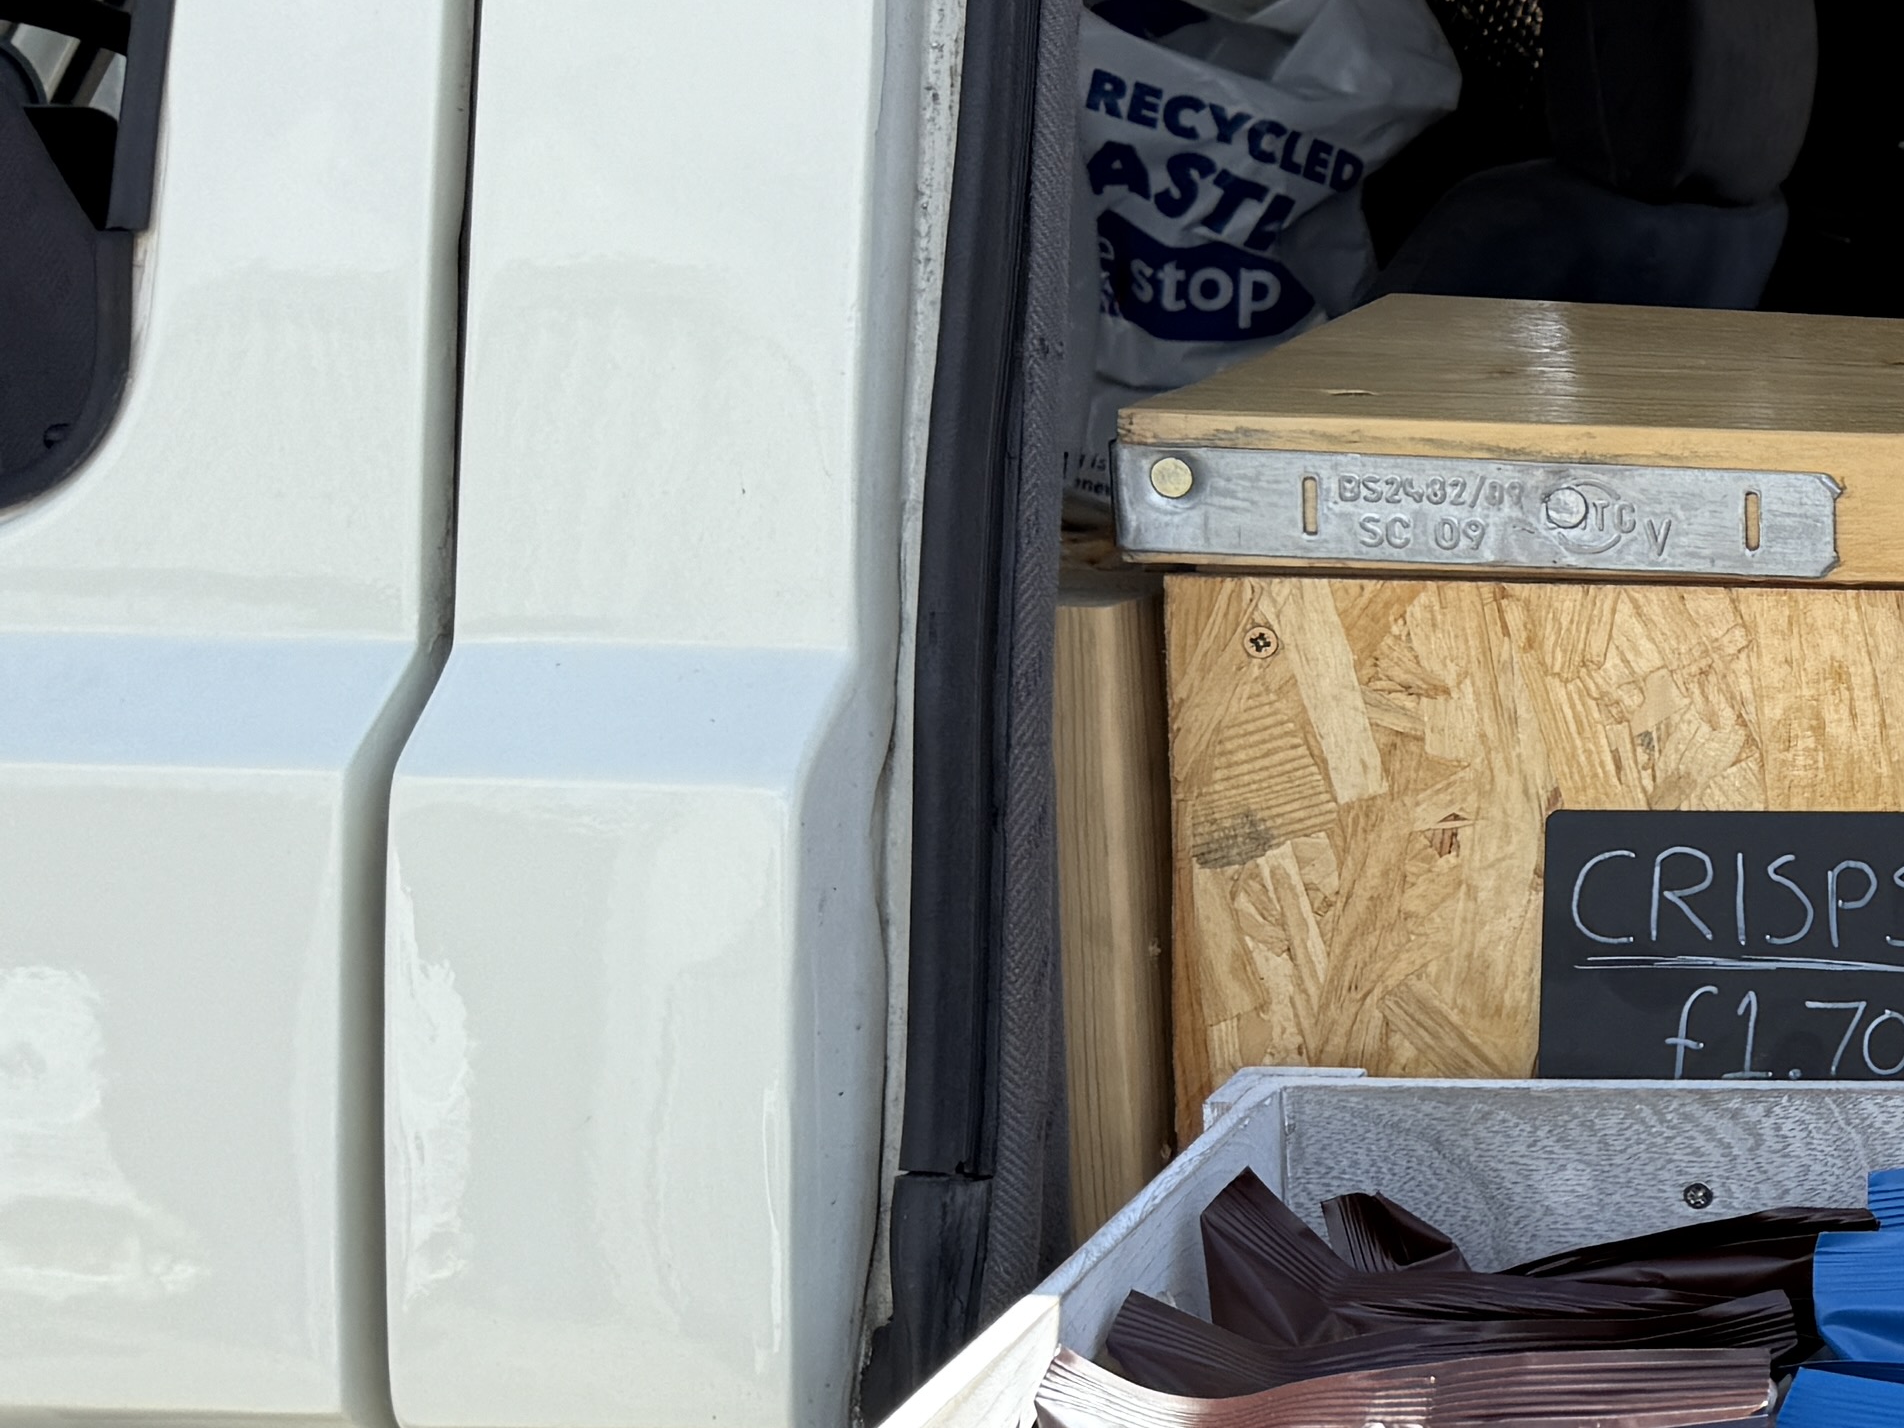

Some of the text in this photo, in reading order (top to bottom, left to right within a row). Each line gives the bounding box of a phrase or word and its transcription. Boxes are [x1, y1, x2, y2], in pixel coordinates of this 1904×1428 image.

[1085, 68, 1365, 193] RECYCLED
[1130, 259, 1283, 330] stop
[1358, 512, 1412, 549] SC
